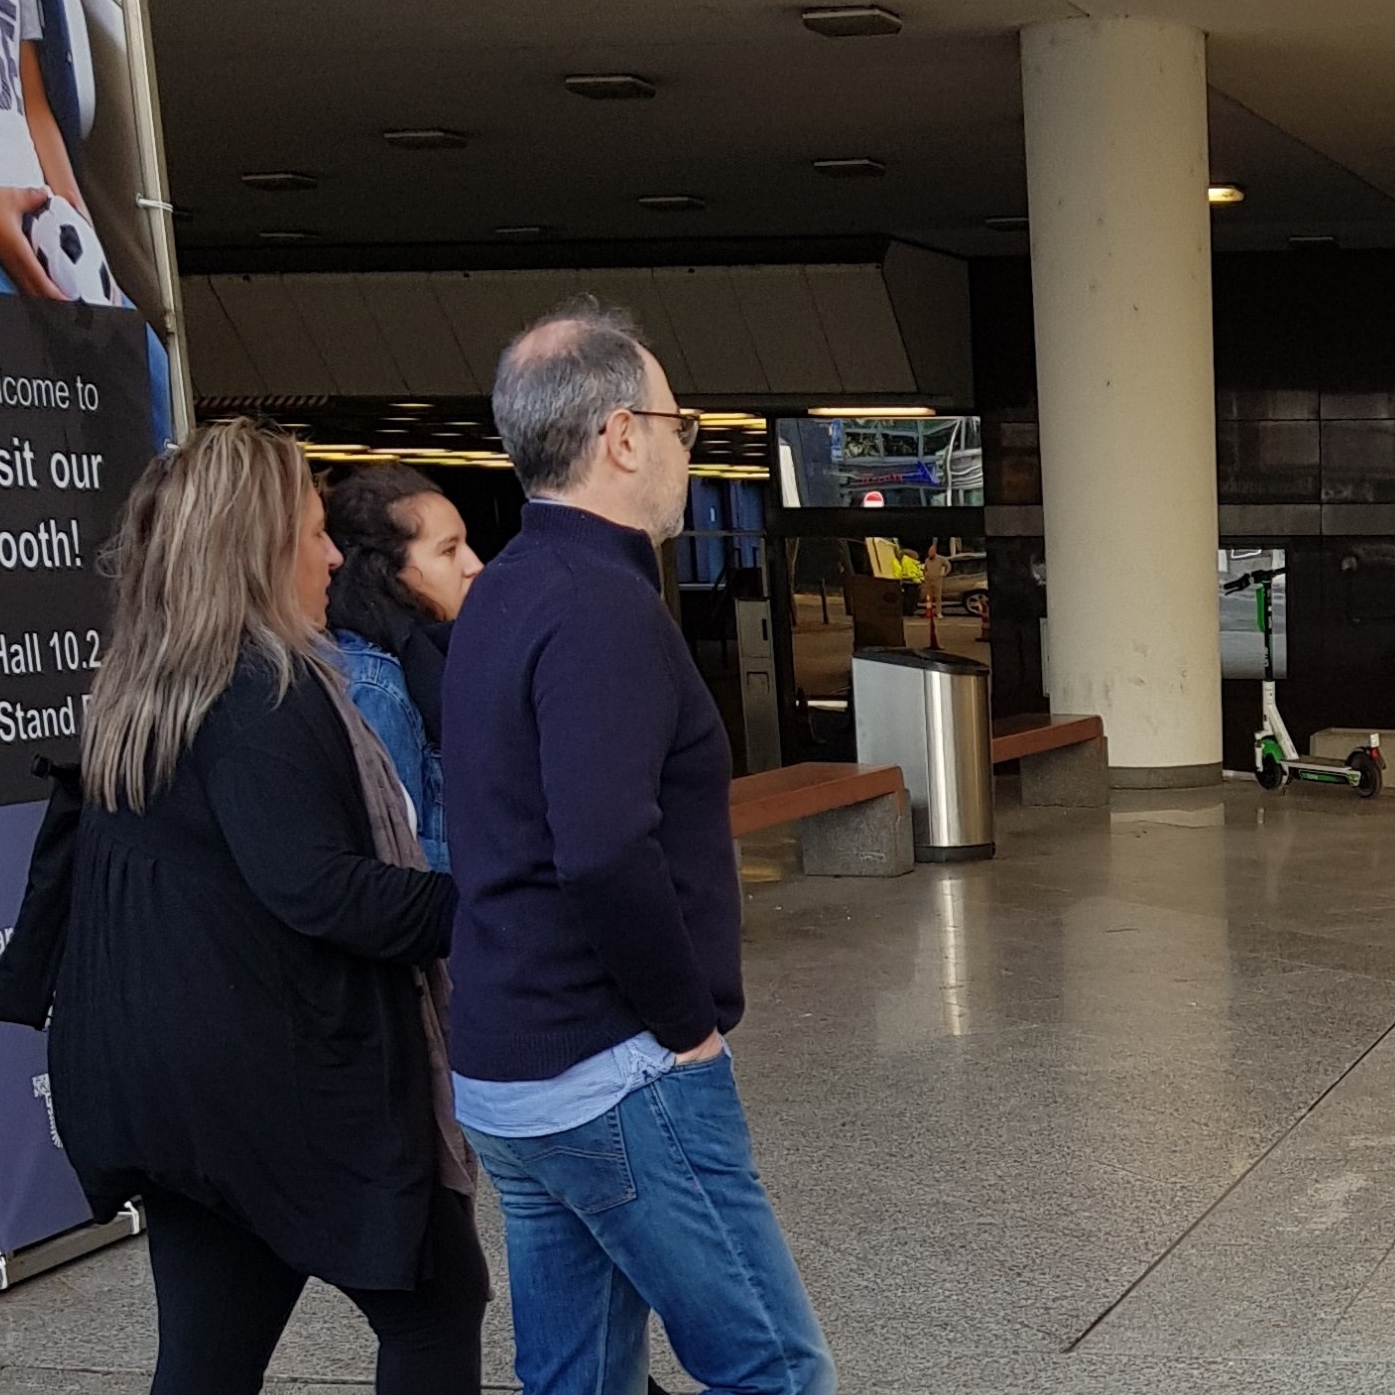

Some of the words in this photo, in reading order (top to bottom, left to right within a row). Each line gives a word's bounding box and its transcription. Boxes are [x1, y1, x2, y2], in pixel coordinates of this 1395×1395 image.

[0, 375, 70, 409] come
[76, 375, 99, 411] to
[51, 453, 103, 489] our
[49, 629, 102, 671] 10.2
[0, 695, 76, 742] Stand
